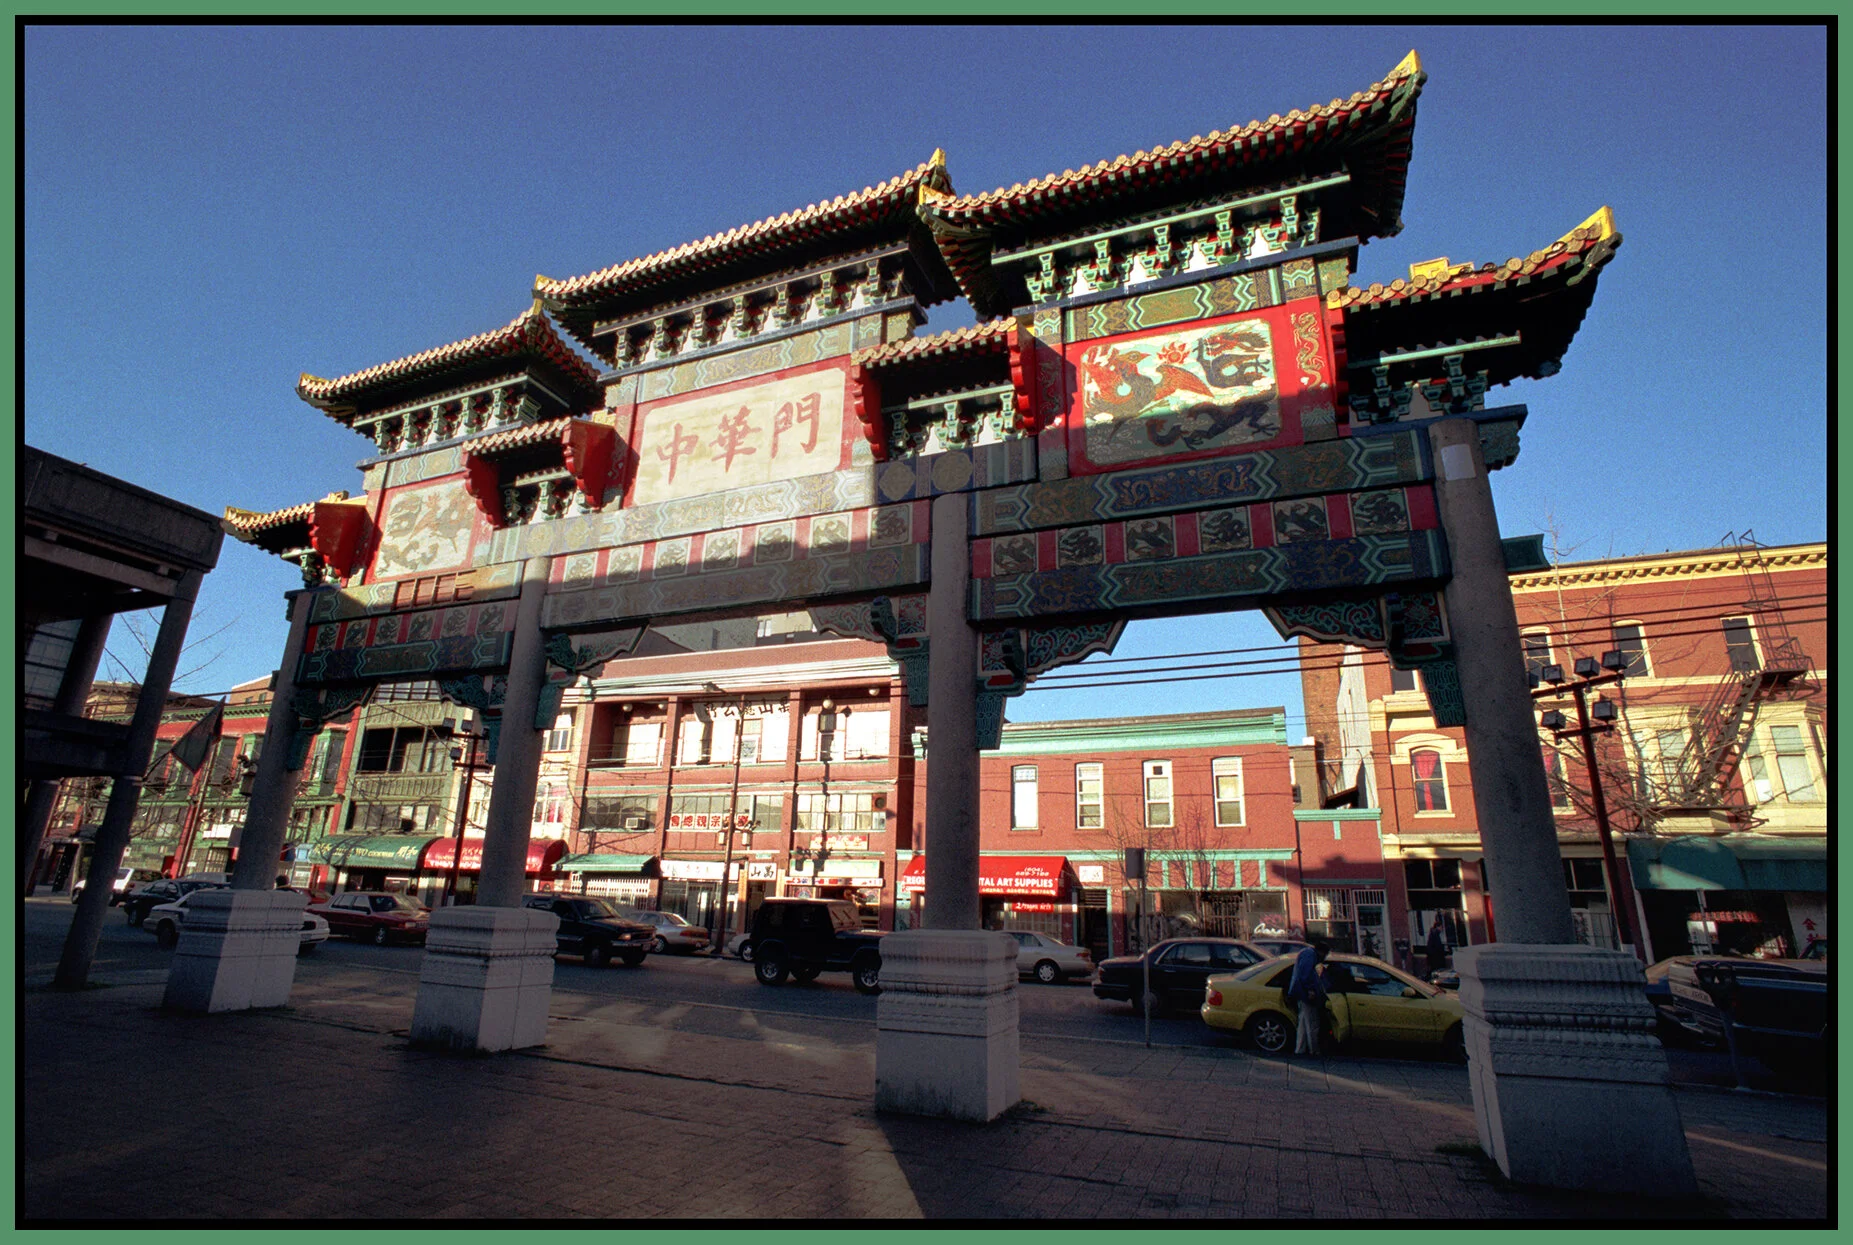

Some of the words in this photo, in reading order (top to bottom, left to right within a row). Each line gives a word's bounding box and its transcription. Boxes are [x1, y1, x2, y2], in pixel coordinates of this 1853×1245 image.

[656, 392, 821, 484] 中華門
[997, 878, 1013, 887] ART
[1014, 878, 1053, 888] SUPPLIES
